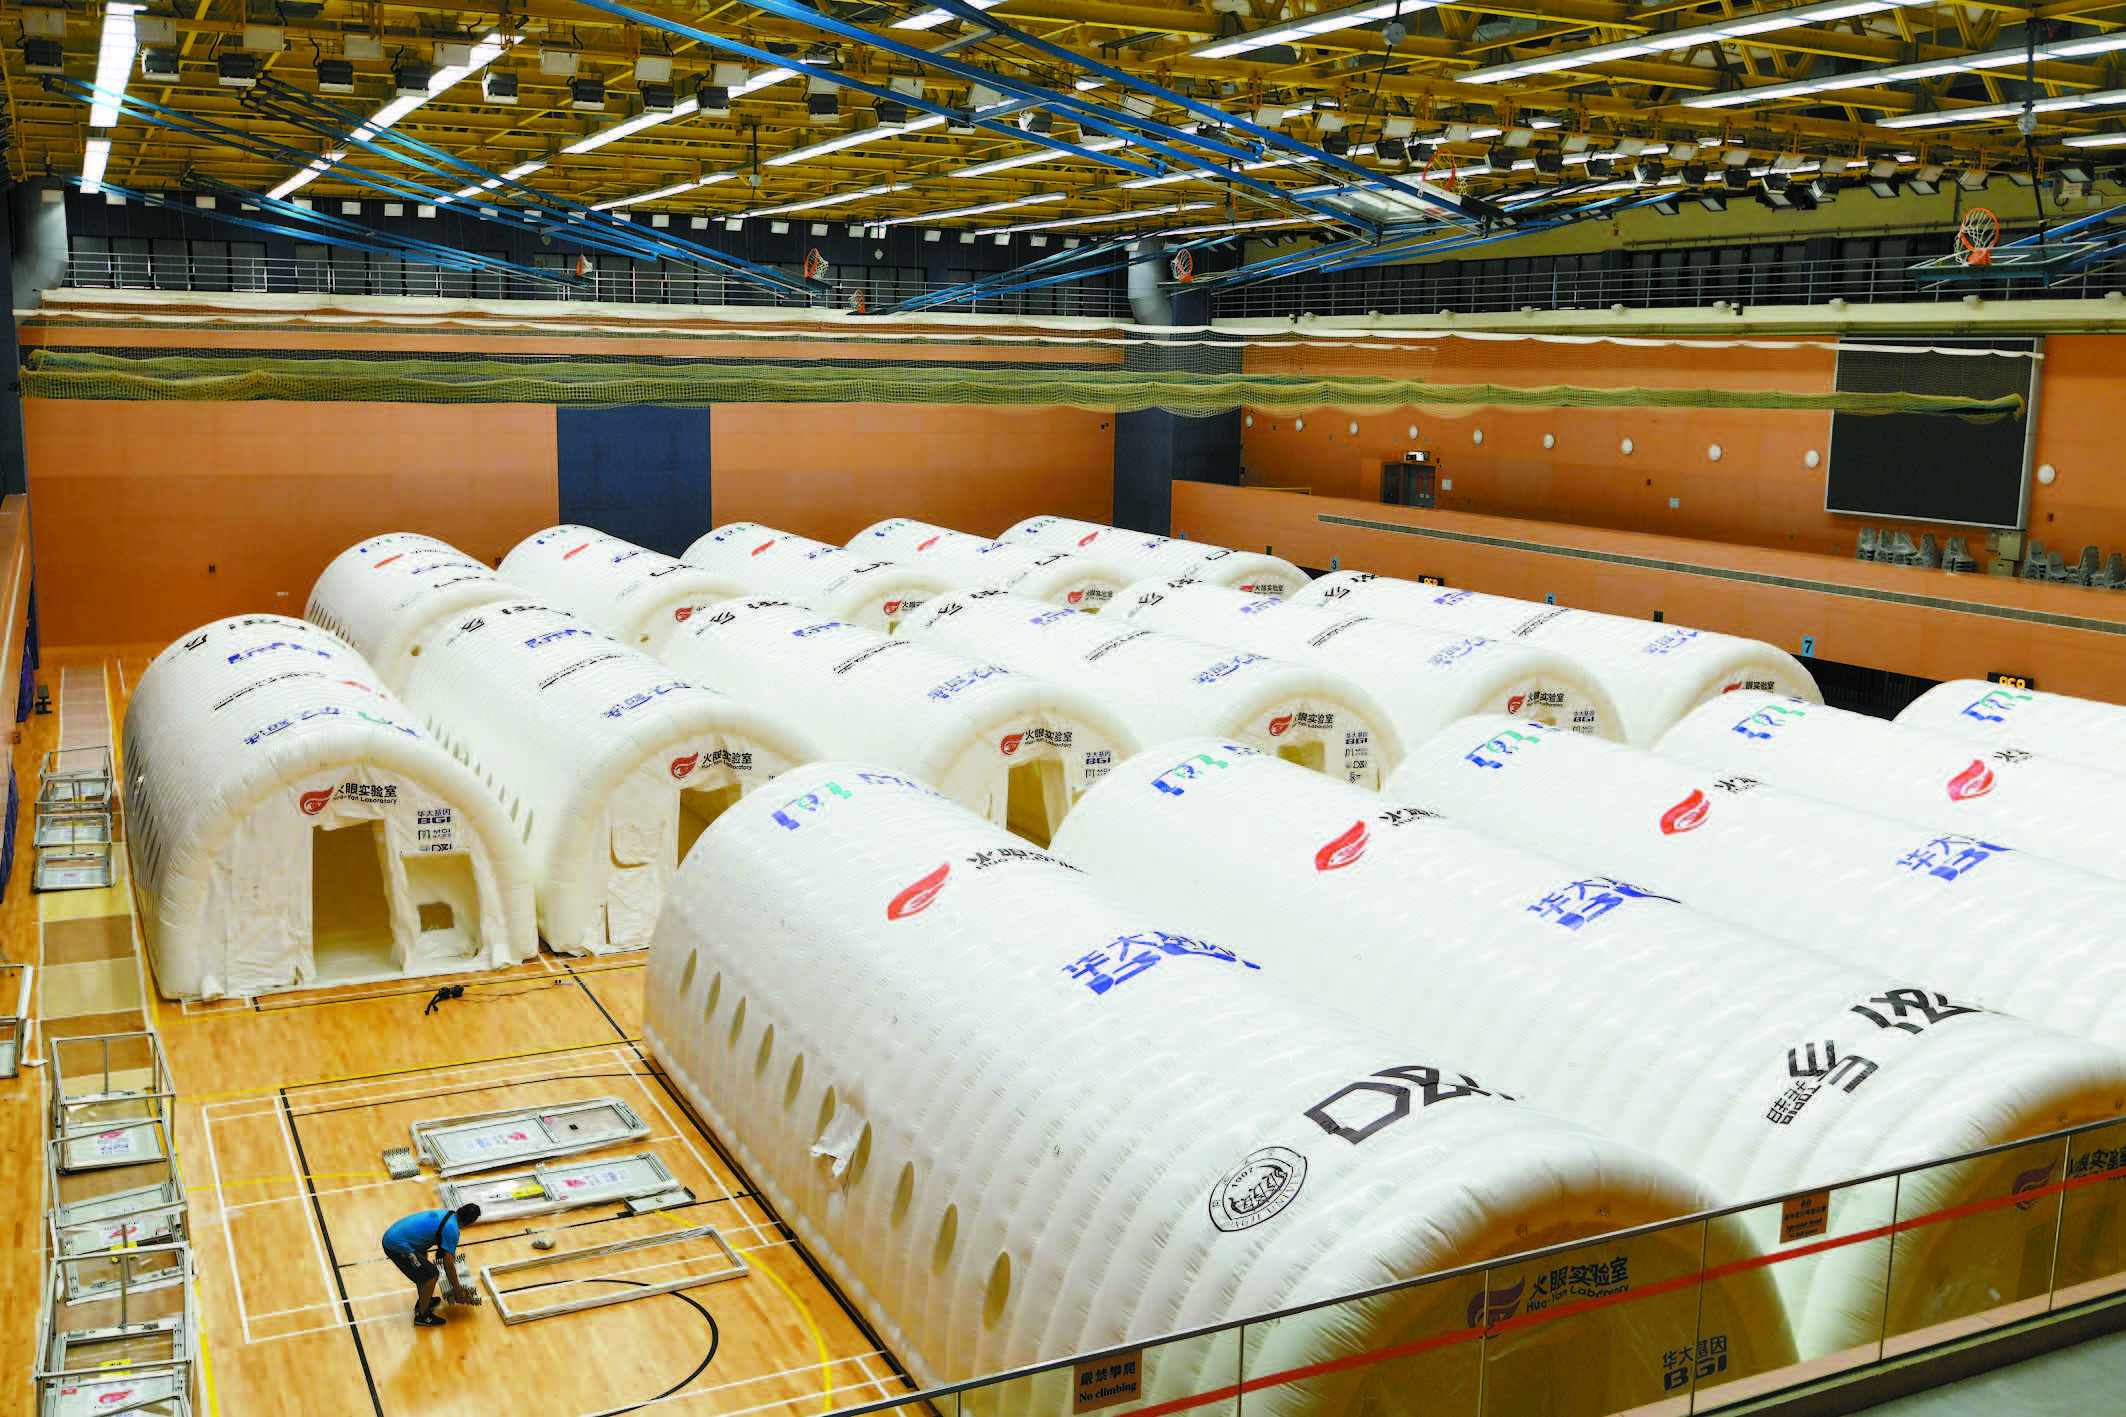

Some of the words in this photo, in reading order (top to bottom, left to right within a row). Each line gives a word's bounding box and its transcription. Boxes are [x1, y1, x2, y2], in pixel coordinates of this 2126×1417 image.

[1332, 559, 1338, 571] 3
[1804, 639, 1813, 654] 7
[1024, 727, 1073, 743] 火眼实验室
[1086, 757, 1112, 765] BGI
[417, 816, 451, 825] BGI
[1529, 1256, 1629, 1300] 火眼实验室
[1526, 1289, 1568, 1313] Huo-Yan
[1663, 1335, 1727, 1370] 华大基因
[1663, 1354, 1727, 1392] BGI
[1079, 1392, 1093, 1402] No
[1095, 1382, 1137, 1398] climbing
